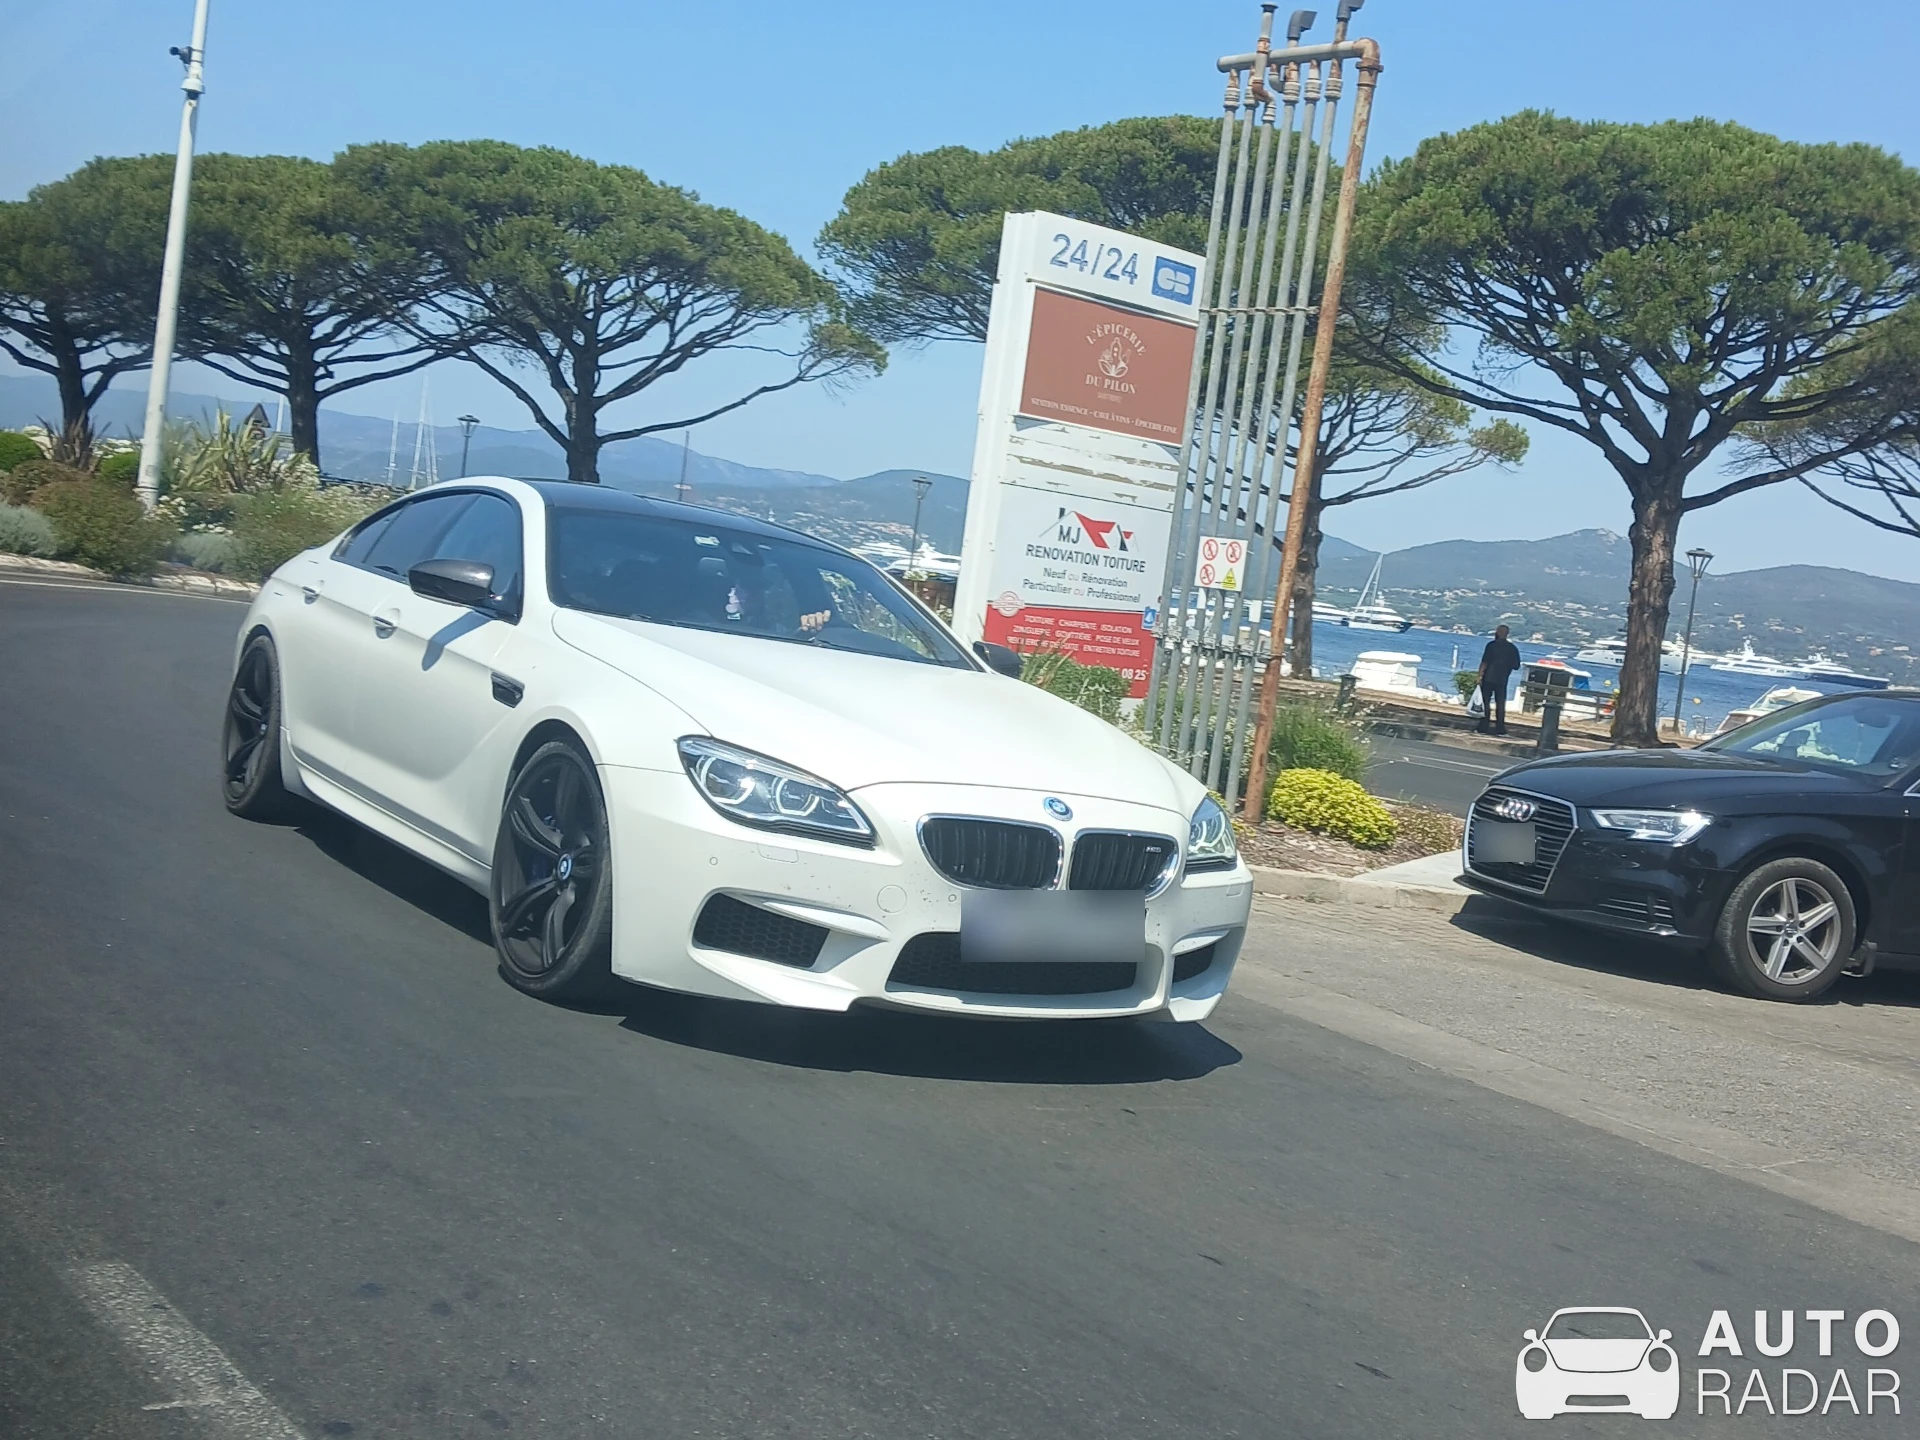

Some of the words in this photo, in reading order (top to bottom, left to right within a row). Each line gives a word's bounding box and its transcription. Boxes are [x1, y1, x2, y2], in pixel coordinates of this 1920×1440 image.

[1050, 234, 1138, 285] 24/24
[1085, 374, 1101, 386] DU
[1103, 378, 1136, 394] PILON
[1057, 525, 1081, 544] MJ
[1026, 544, 1101, 567] RENOVATION
[1103, 555, 1147, 573] TOITURE
[1043, 567, 1067, 580] Neuf
[1068, 573, 1080, 581] ou
[1081, 572, 1128, 588] Rénovation
[1022, 578, 1072, 594] Particulier
[1073, 588, 1085, 597] ou
[1087, 587, 1141, 603] Professionnel
[1058, 619, 1097, 631] CHARPENTE
[1100, 624, 1133, 634] ISOLATION
[1134, 669, 1146, 680] 25
